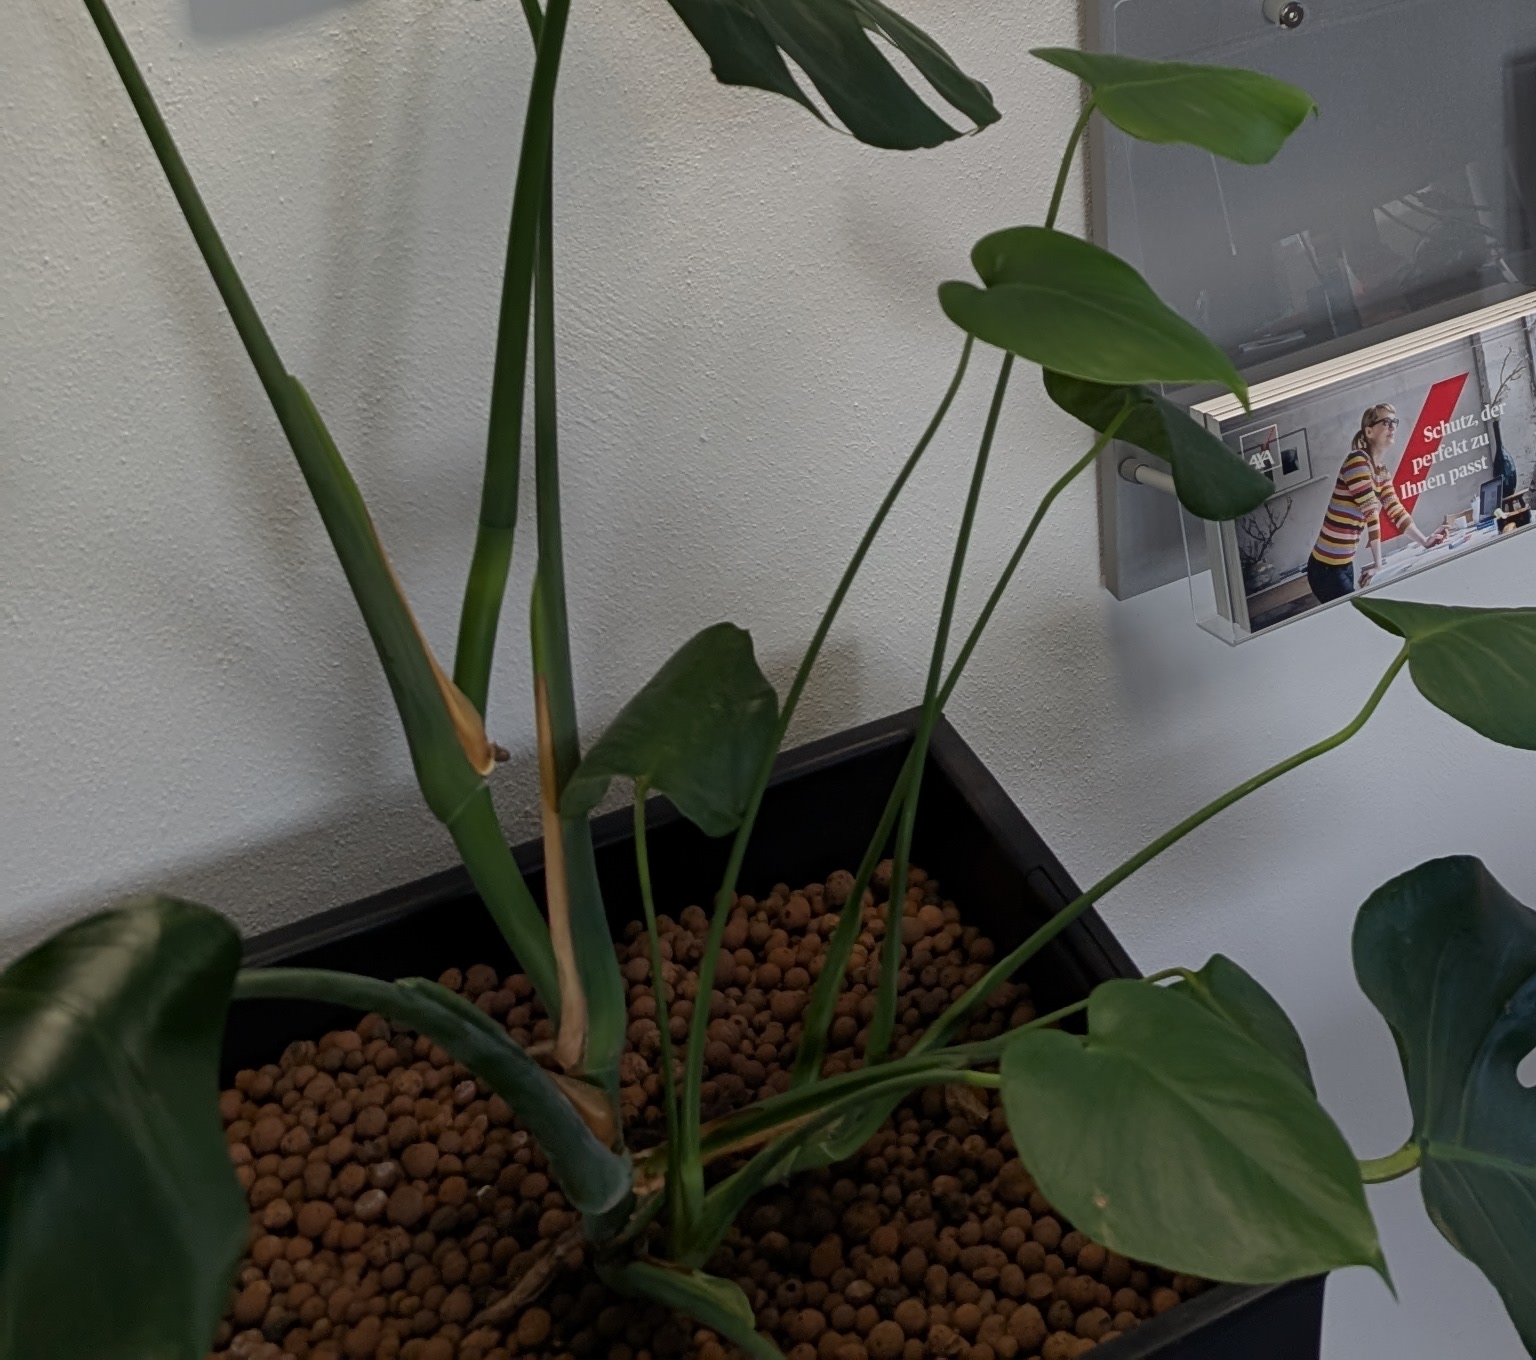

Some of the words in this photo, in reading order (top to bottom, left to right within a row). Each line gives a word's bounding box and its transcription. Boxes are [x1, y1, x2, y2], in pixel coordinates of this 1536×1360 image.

[1423, 413, 1479, 443] Schutz,
[1480, 400, 1507, 423] der
[1410, 436, 1465, 476] perfekt
[1469, 430, 1491, 450] zu
[1399, 472, 1448, 501] Ihnen
[1448, 455, 1490, 491] passt
